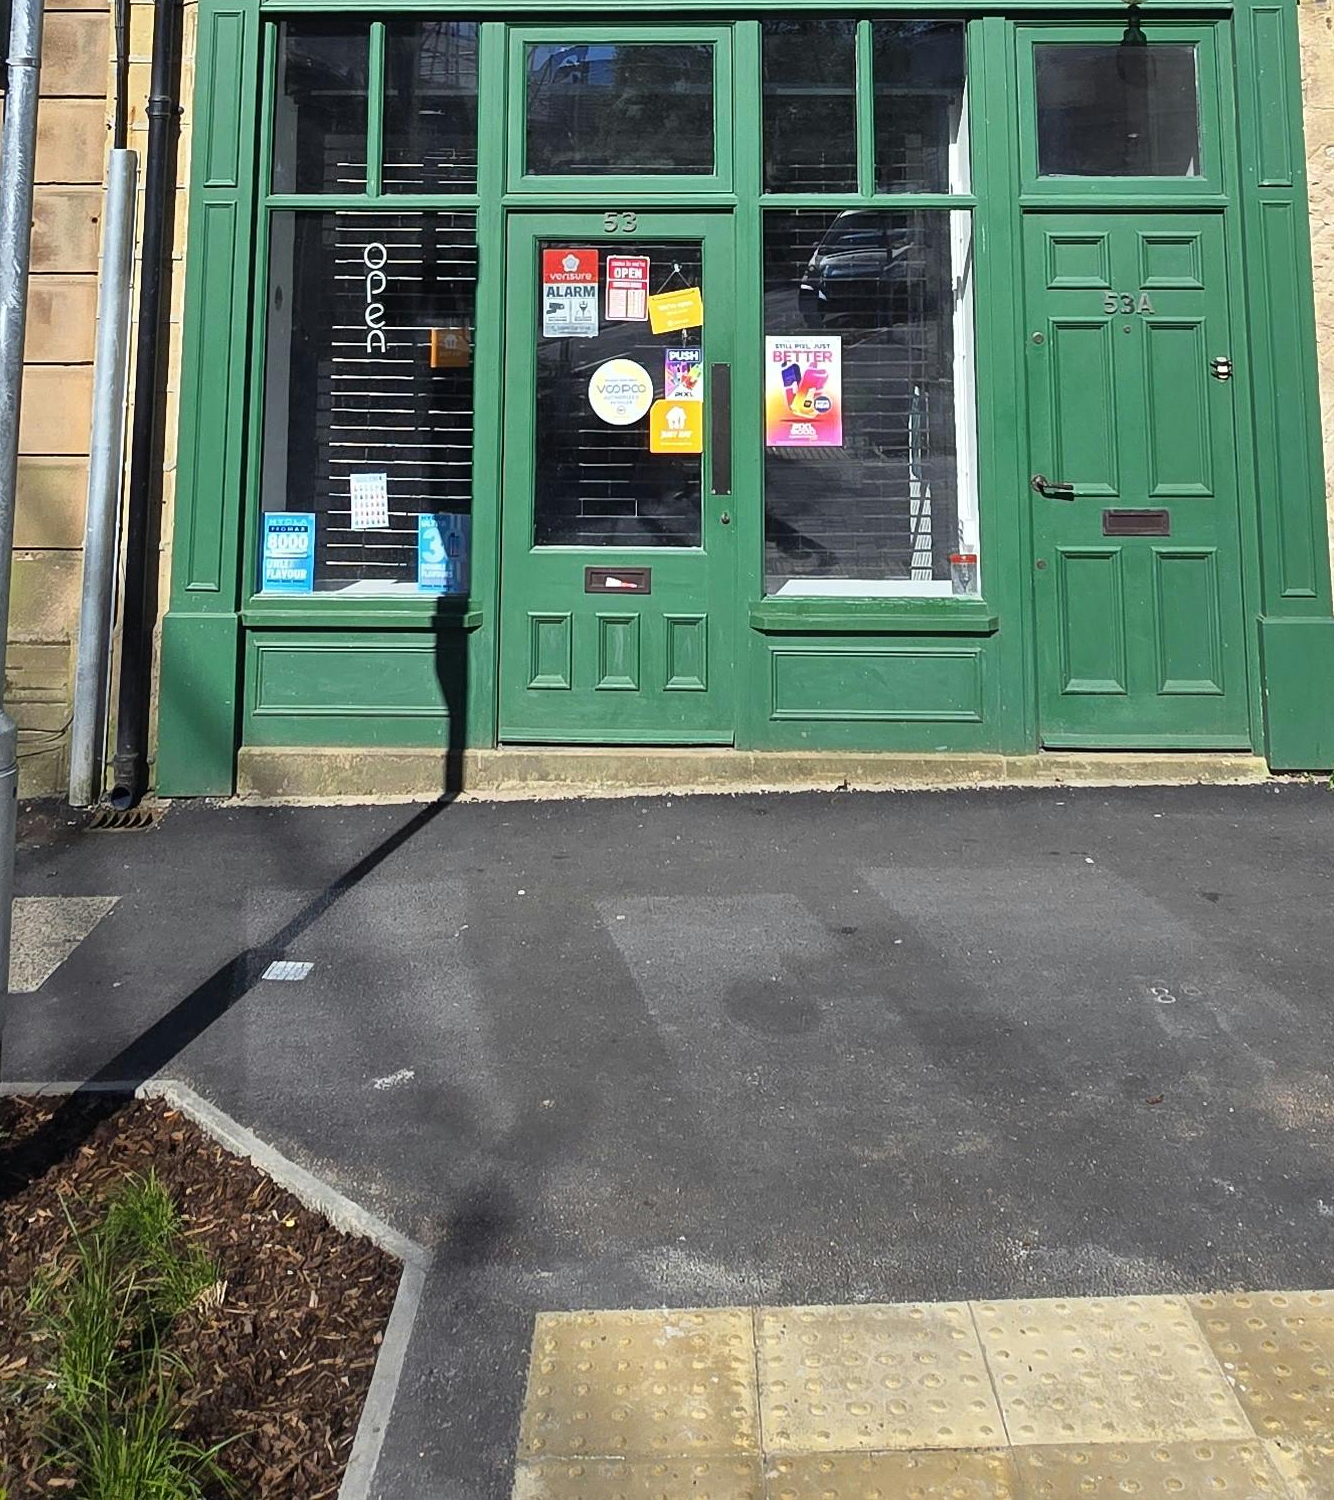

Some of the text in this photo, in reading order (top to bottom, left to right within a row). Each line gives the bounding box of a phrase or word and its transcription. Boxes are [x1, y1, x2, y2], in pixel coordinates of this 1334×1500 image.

[603, 211, 638, 234] 53
[613, 267, 643, 279] OPEN
[546, 286, 596, 298] ALARM
[1102, 291, 1156, 315] 53A
[668, 350, 699, 361] PUSH
[772, 350, 833, 363] BETTER
